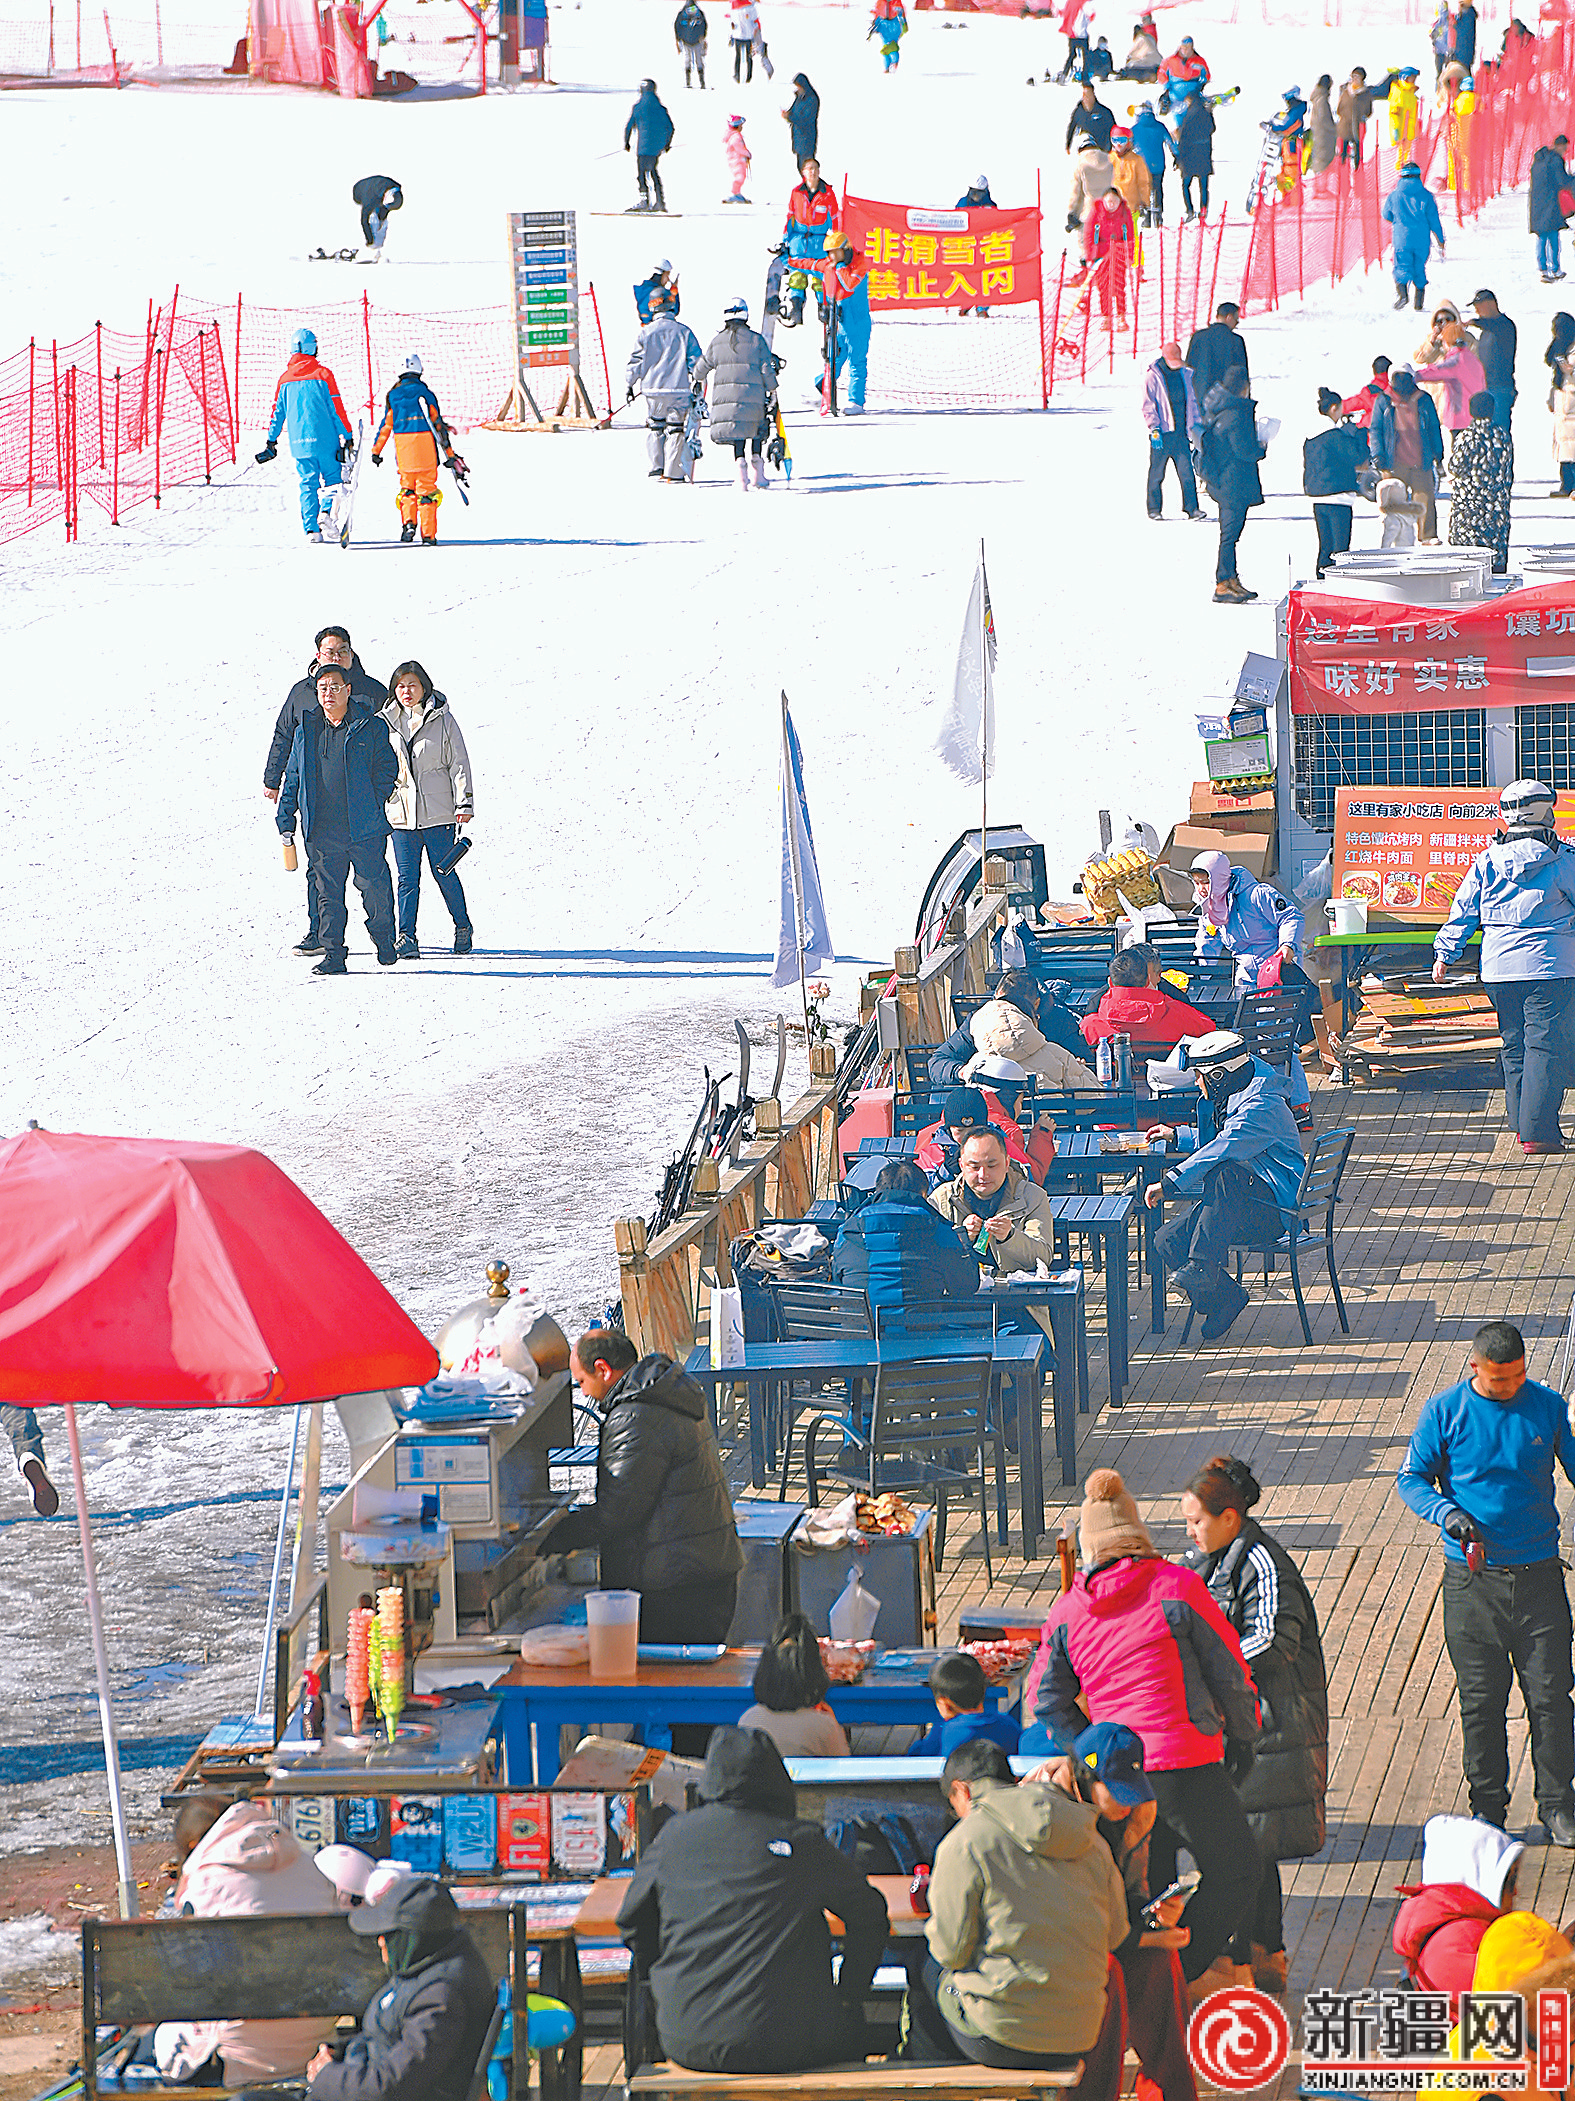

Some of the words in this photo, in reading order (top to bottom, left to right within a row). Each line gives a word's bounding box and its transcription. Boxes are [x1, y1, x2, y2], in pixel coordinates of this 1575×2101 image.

[865, 227, 1017, 265] 非滑雪者
[866, 264, 1015, 301] 禁止入内
[1348, 802, 1443, 819] 这里有家小吃店
[1448, 803, 1500, 820] 向前2米
[1344, 850, 1414, 865] 红烧牛肉面
